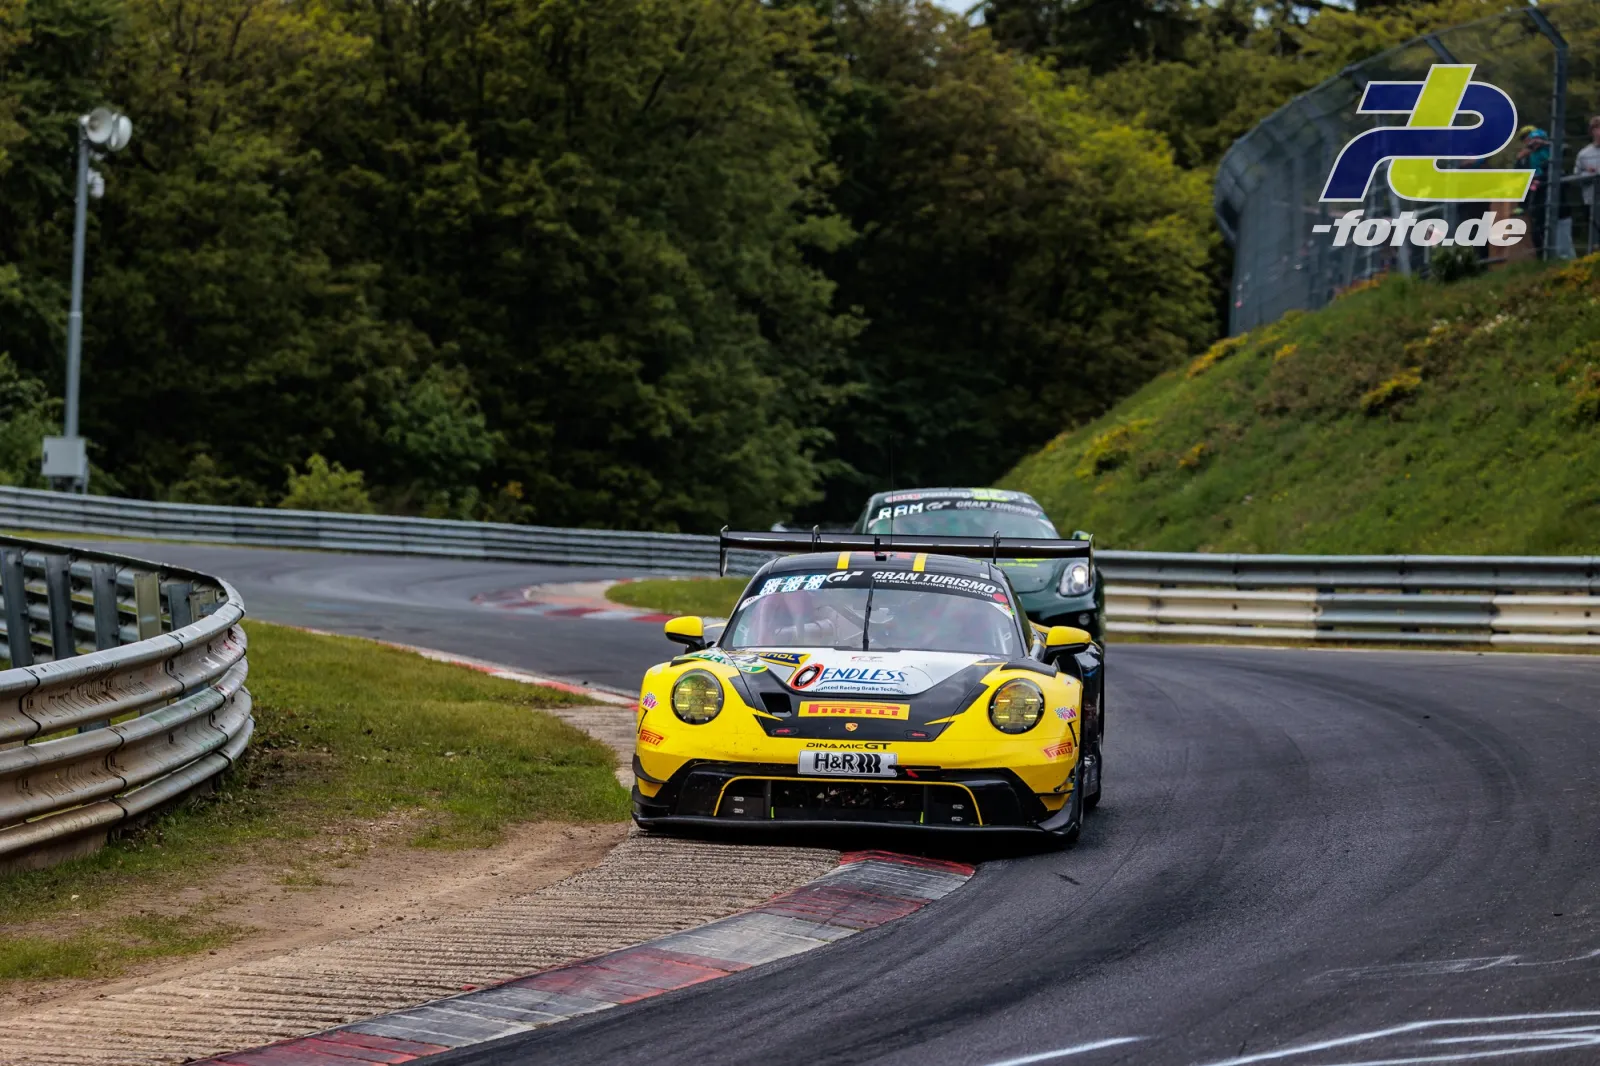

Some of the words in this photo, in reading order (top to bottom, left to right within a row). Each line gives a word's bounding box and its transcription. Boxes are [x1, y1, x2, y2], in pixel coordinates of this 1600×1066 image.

[878, 502, 924, 520] RAM
[955, 500, 988, 510] GRAN
[990, 502, 1041, 518] TURISMO
[872, 570, 920, 581] GRAN
[920, 573, 997, 594] TURISMO
[911, 580, 945, 588] DRIVING
[946, 585, 993, 598] SIMULATOR
[820, 667, 908, 683] ENDLESS
[808, 703, 901, 717] PIRELLI
[814, 752, 857, 773] H&R
